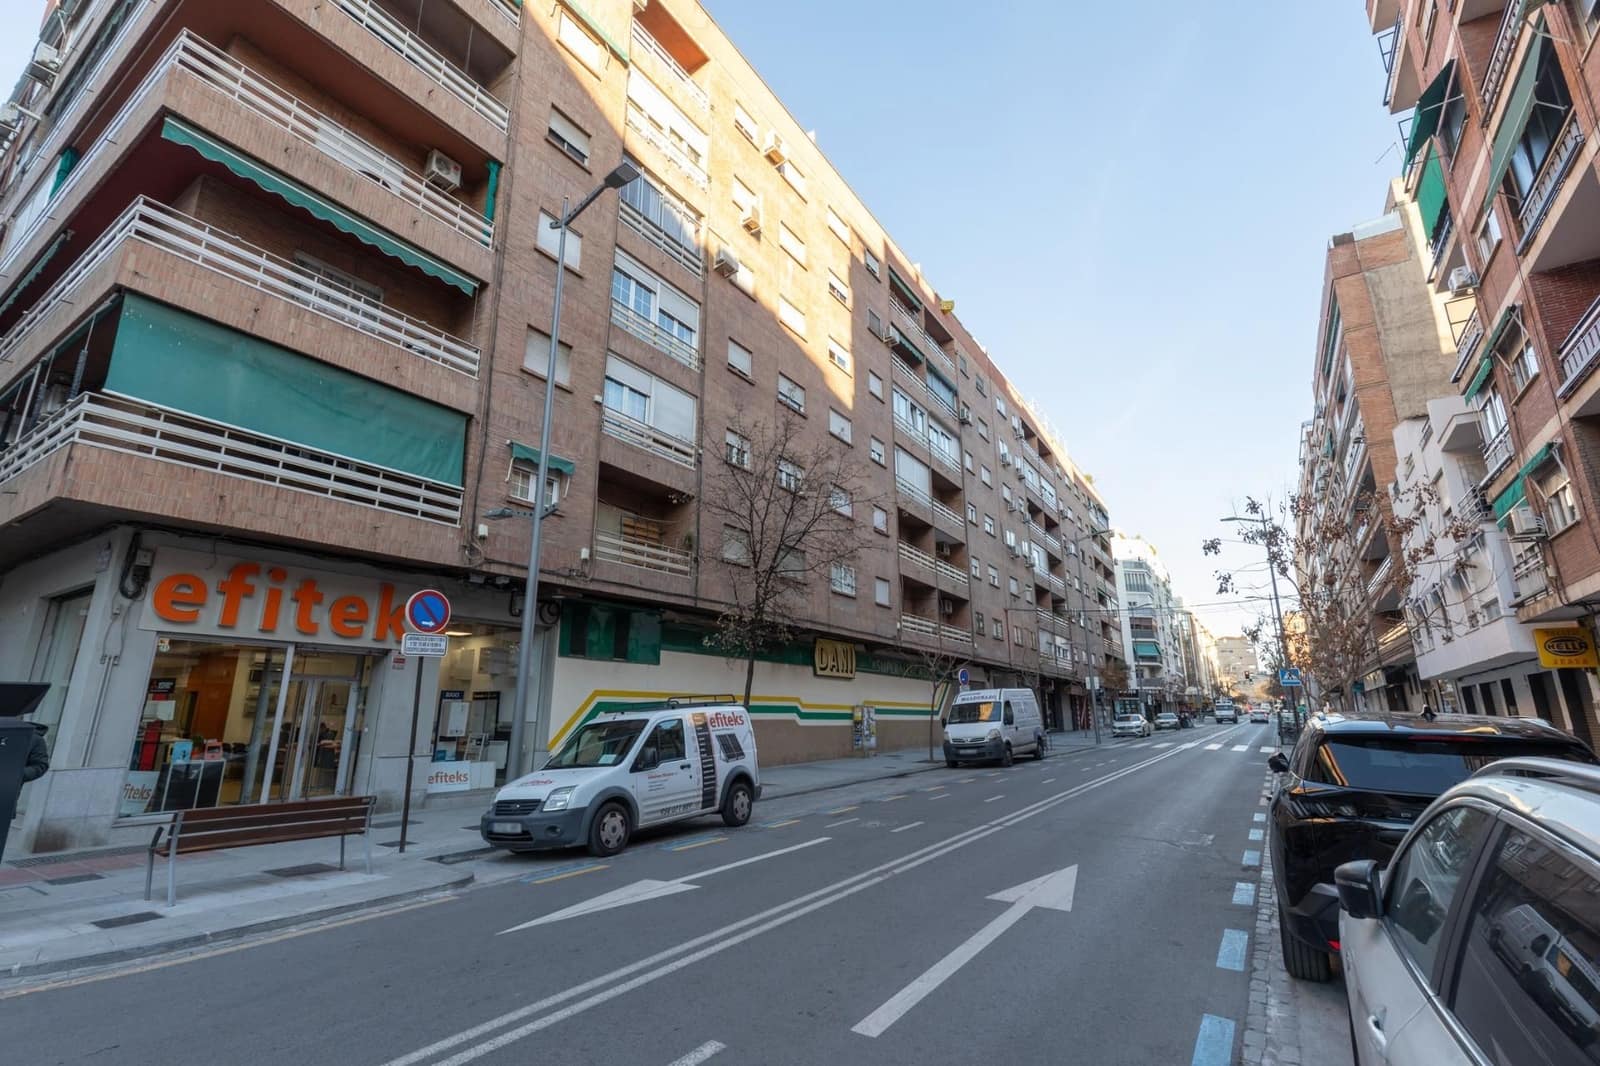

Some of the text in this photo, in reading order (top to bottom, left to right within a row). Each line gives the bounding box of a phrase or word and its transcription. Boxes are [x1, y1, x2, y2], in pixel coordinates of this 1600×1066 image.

[153, 562, 407, 644] efitek
[818, 645, 854, 675] DANI
[710, 711, 745, 728] efiteks
[427, 770, 469, 785] efiteks
[123, 783, 152, 800] fiteks
